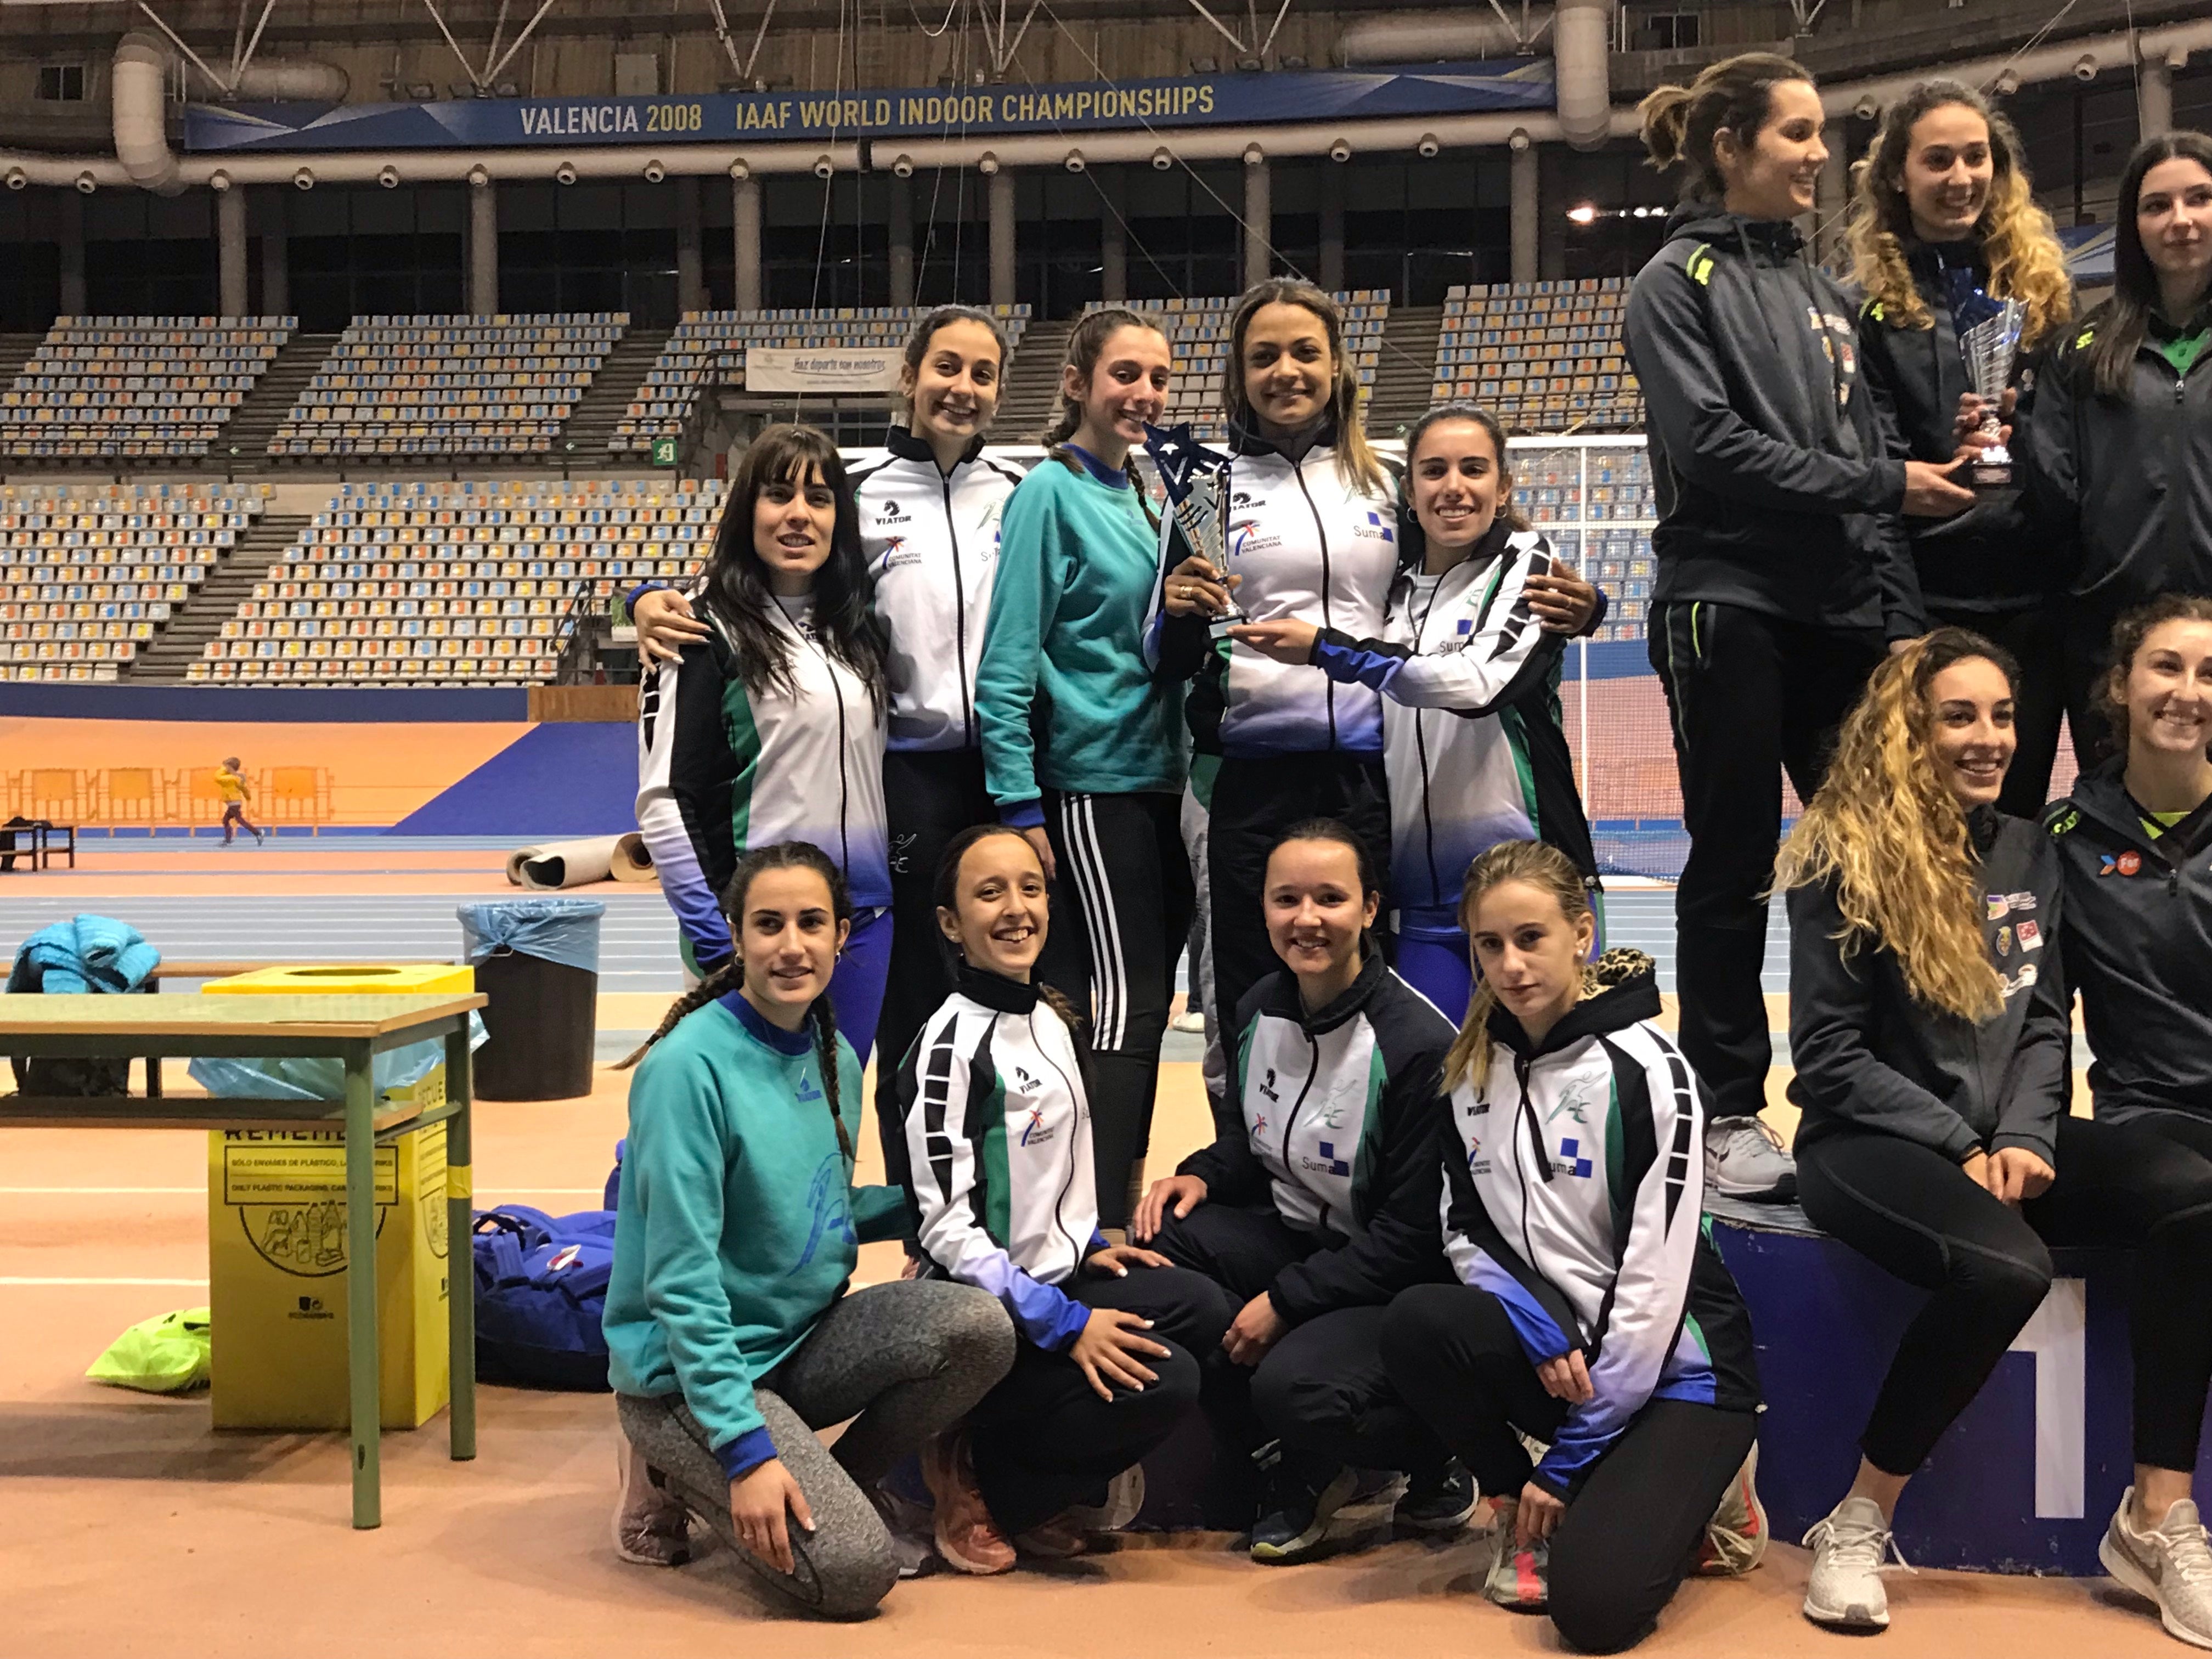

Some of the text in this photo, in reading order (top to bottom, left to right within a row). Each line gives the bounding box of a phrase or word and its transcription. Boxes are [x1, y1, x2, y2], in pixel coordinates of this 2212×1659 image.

[521, 85, 1214, 135] VALENCIA 2008 IAAF WORLD INDOOR CHAMPIONSHIPS
[875, 515, 912, 526] VIATOR
[1353, 525, 1385, 540] Suma
[1241, 541, 1283, 554] VALENCIANA
[1242, 535, 1281, 548] COMUNITAT
[888, 558, 922, 568] VALENCIANA
[889, 552, 922, 561] COMUNITAT
[1439, 641, 1464, 653] Sum
[1302, 1156, 1335, 1175] Suma
[1548, 1162, 1577, 1176] uma
[2007, 1278, 2085, 1518] 1
